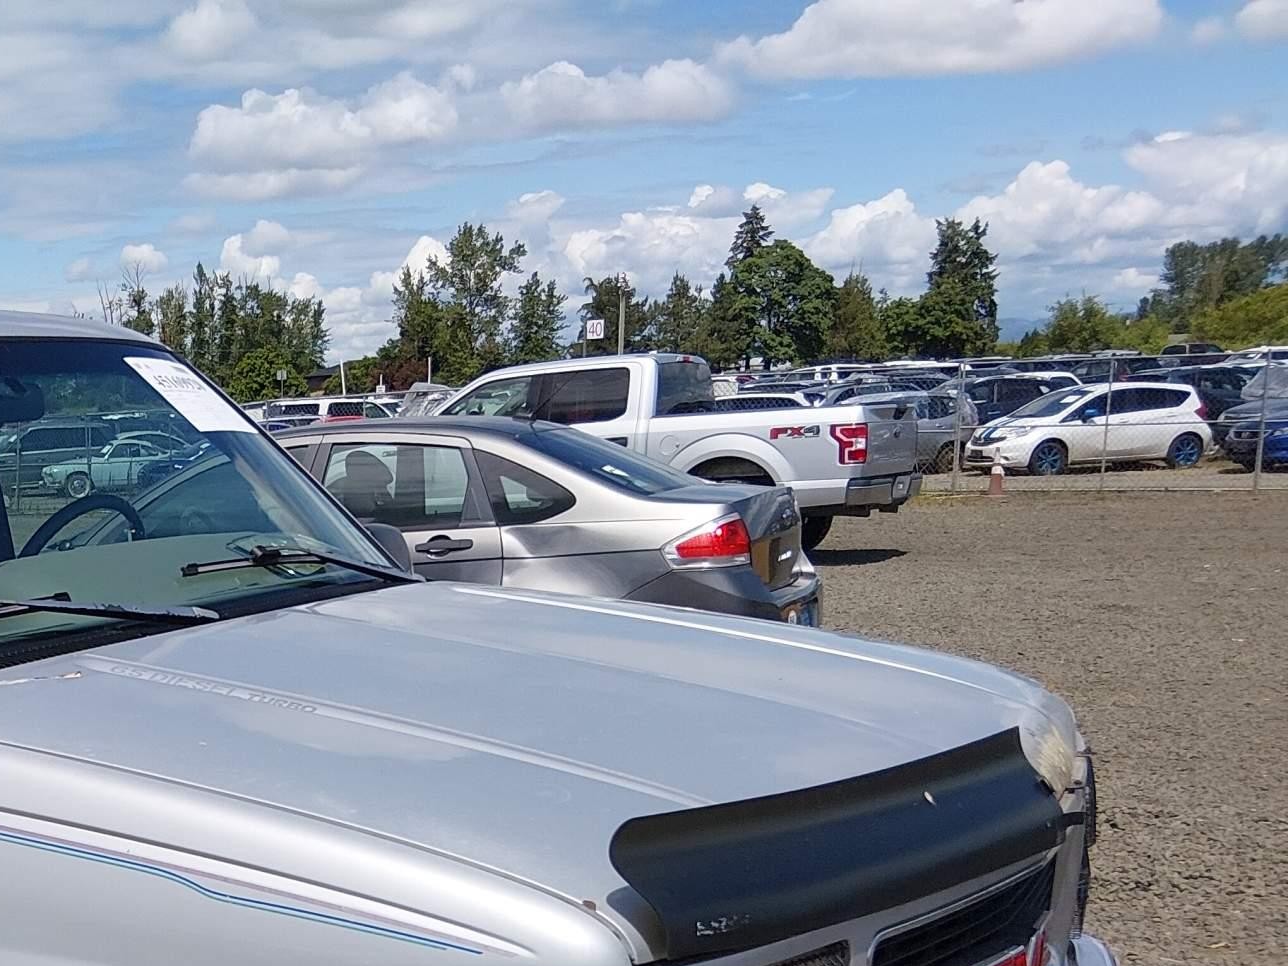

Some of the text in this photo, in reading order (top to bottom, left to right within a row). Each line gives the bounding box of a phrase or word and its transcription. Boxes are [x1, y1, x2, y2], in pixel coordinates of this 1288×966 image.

[588, 322, 603, 337] 40
[770, 425, 820, 440] FX4
[247, 693, 318, 713] TURBO
